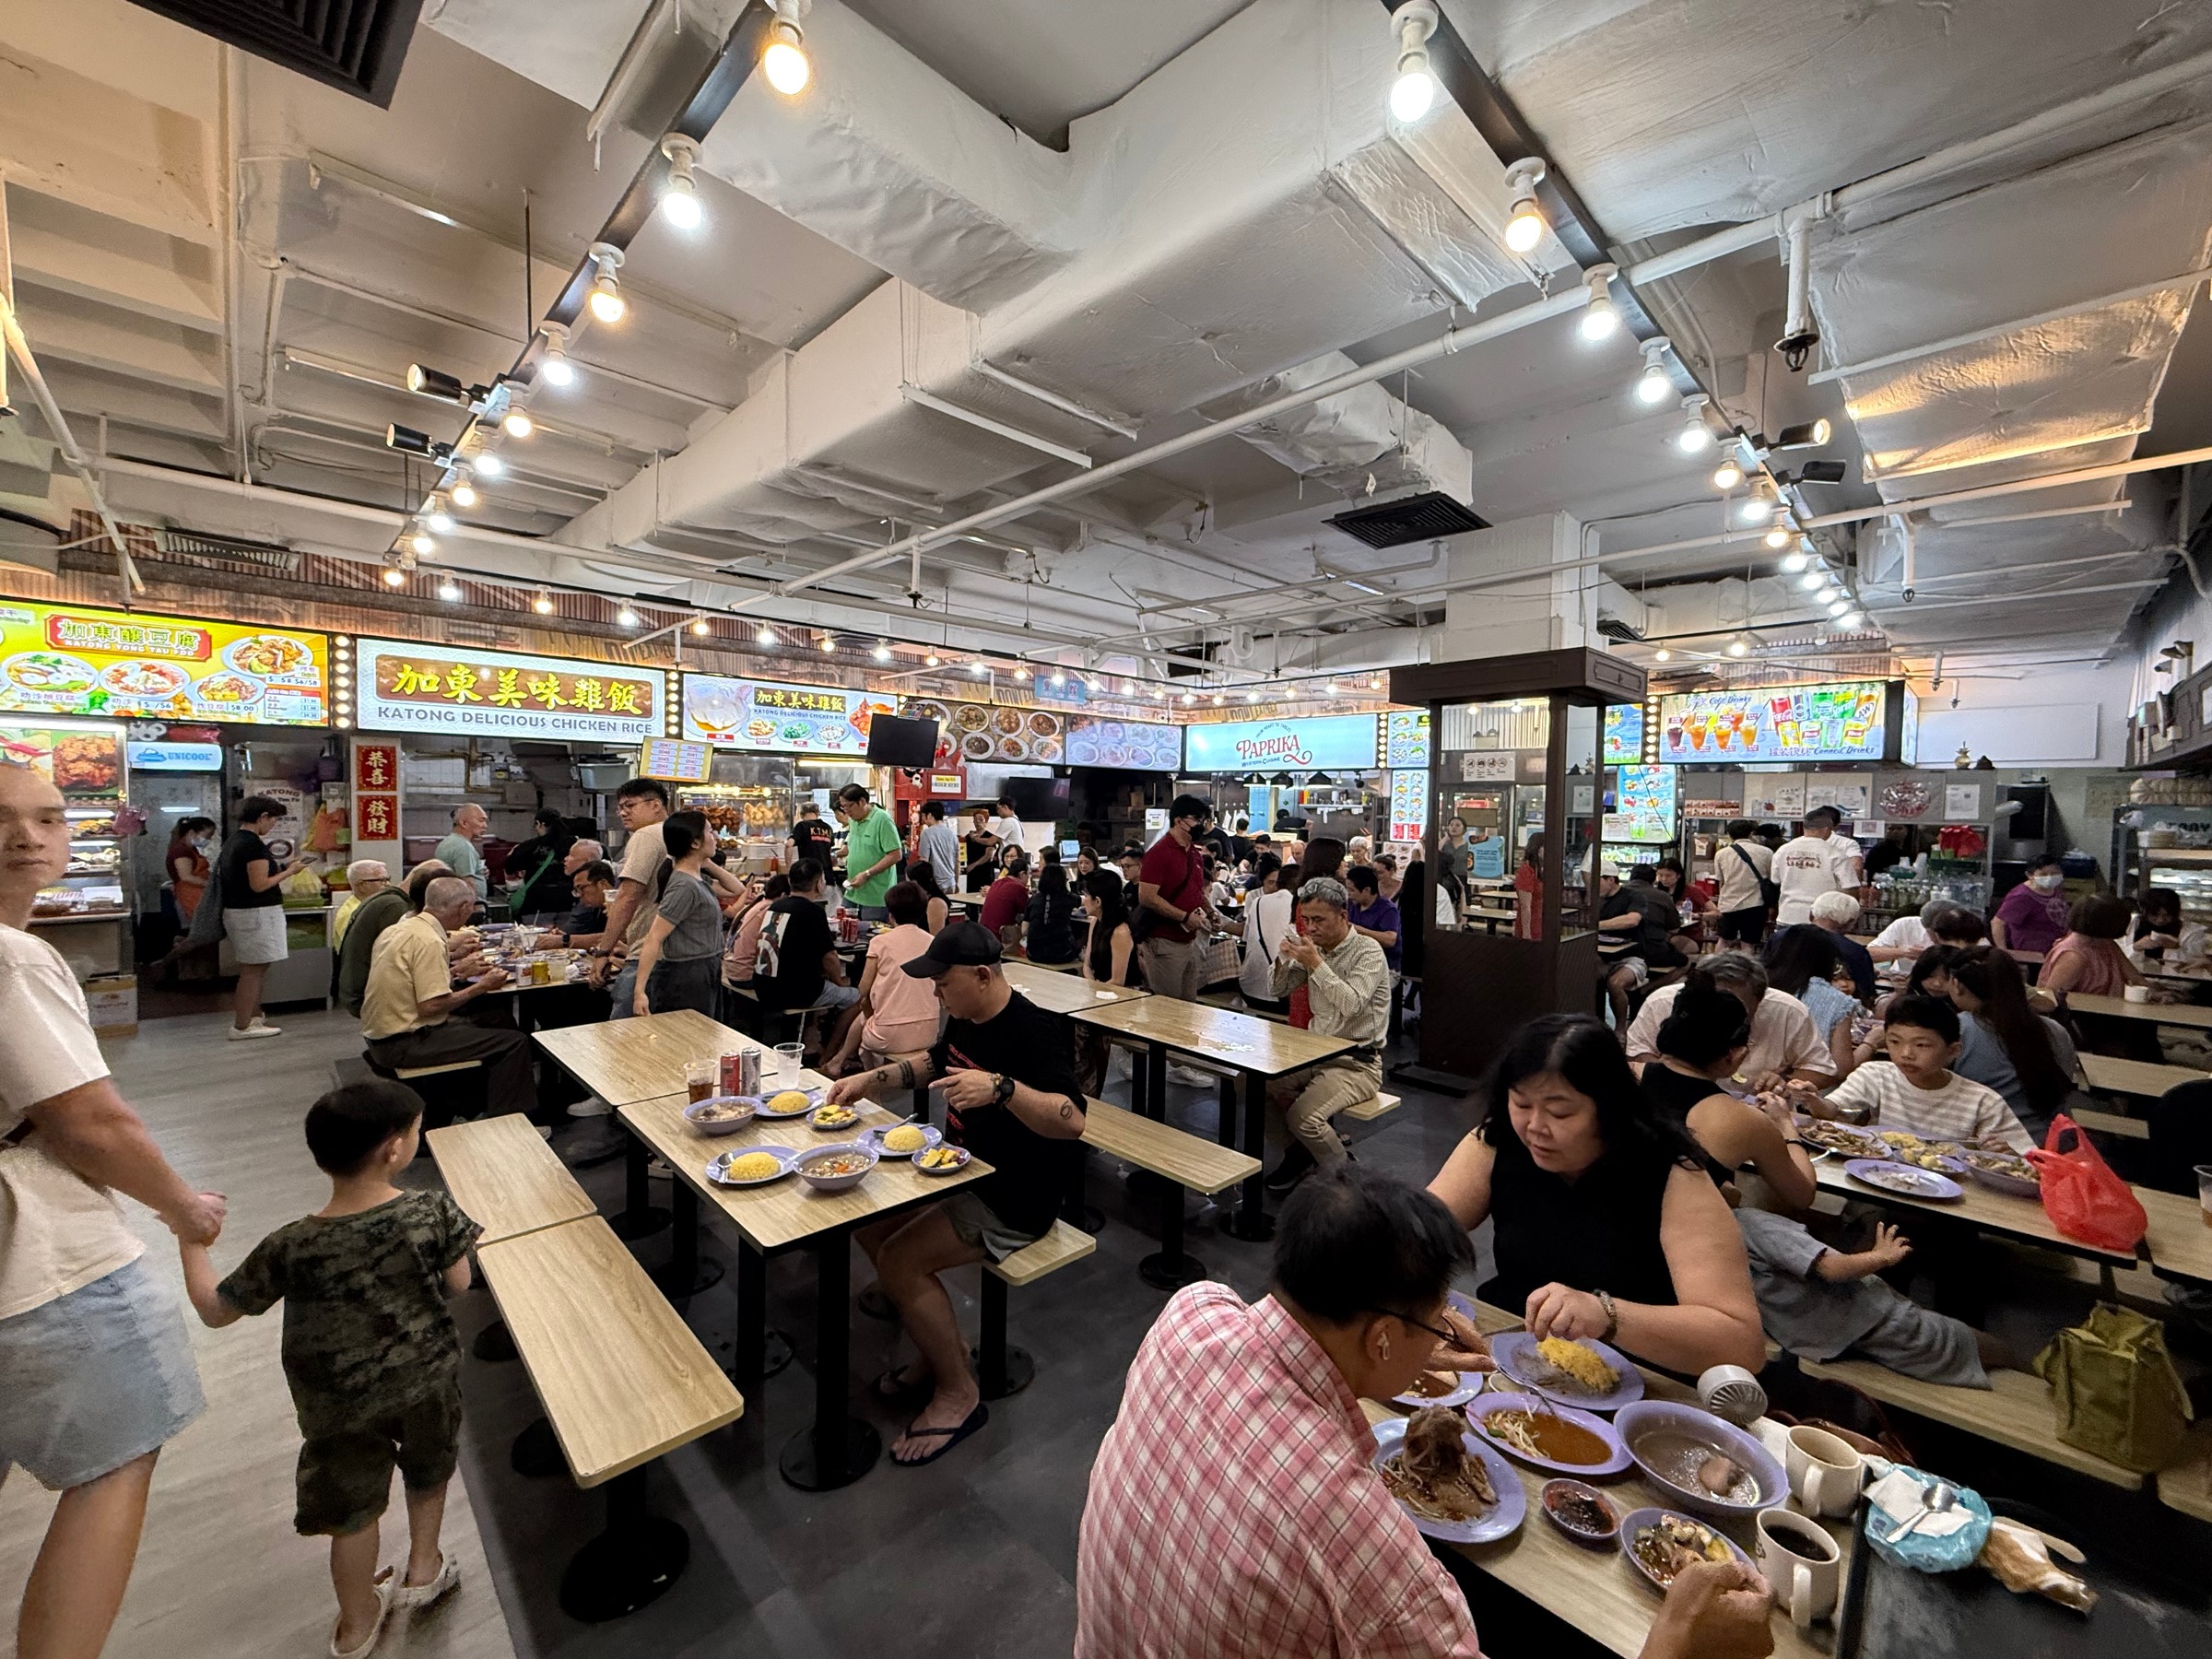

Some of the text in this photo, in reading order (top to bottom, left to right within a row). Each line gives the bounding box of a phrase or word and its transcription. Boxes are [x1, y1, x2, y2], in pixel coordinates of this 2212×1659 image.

[65, 640, 111, 650] KATONG
[116, 644, 146, 653] YONG
[391, 663, 644, 716] 加東美味雞飯
[756, 689, 845, 713] 加東美味雞飯
[1709, 696, 1725, 704] Cold
[1727, 695, 1752, 704] Drinks
[377, 705, 653, 734] KATONG DELICIOUS CHICKEN RICE
[780, 710, 808, 718] DELICIOUS
[167, 752, 211, 761] UNICOOL
[1236, 735, 1300, 760] PAPRIKA
[1813, 746, 1875, 755] Canned Drinks
[365, 750, 388, 785] 恭喜
[367, 800, 390, 834] 發財
